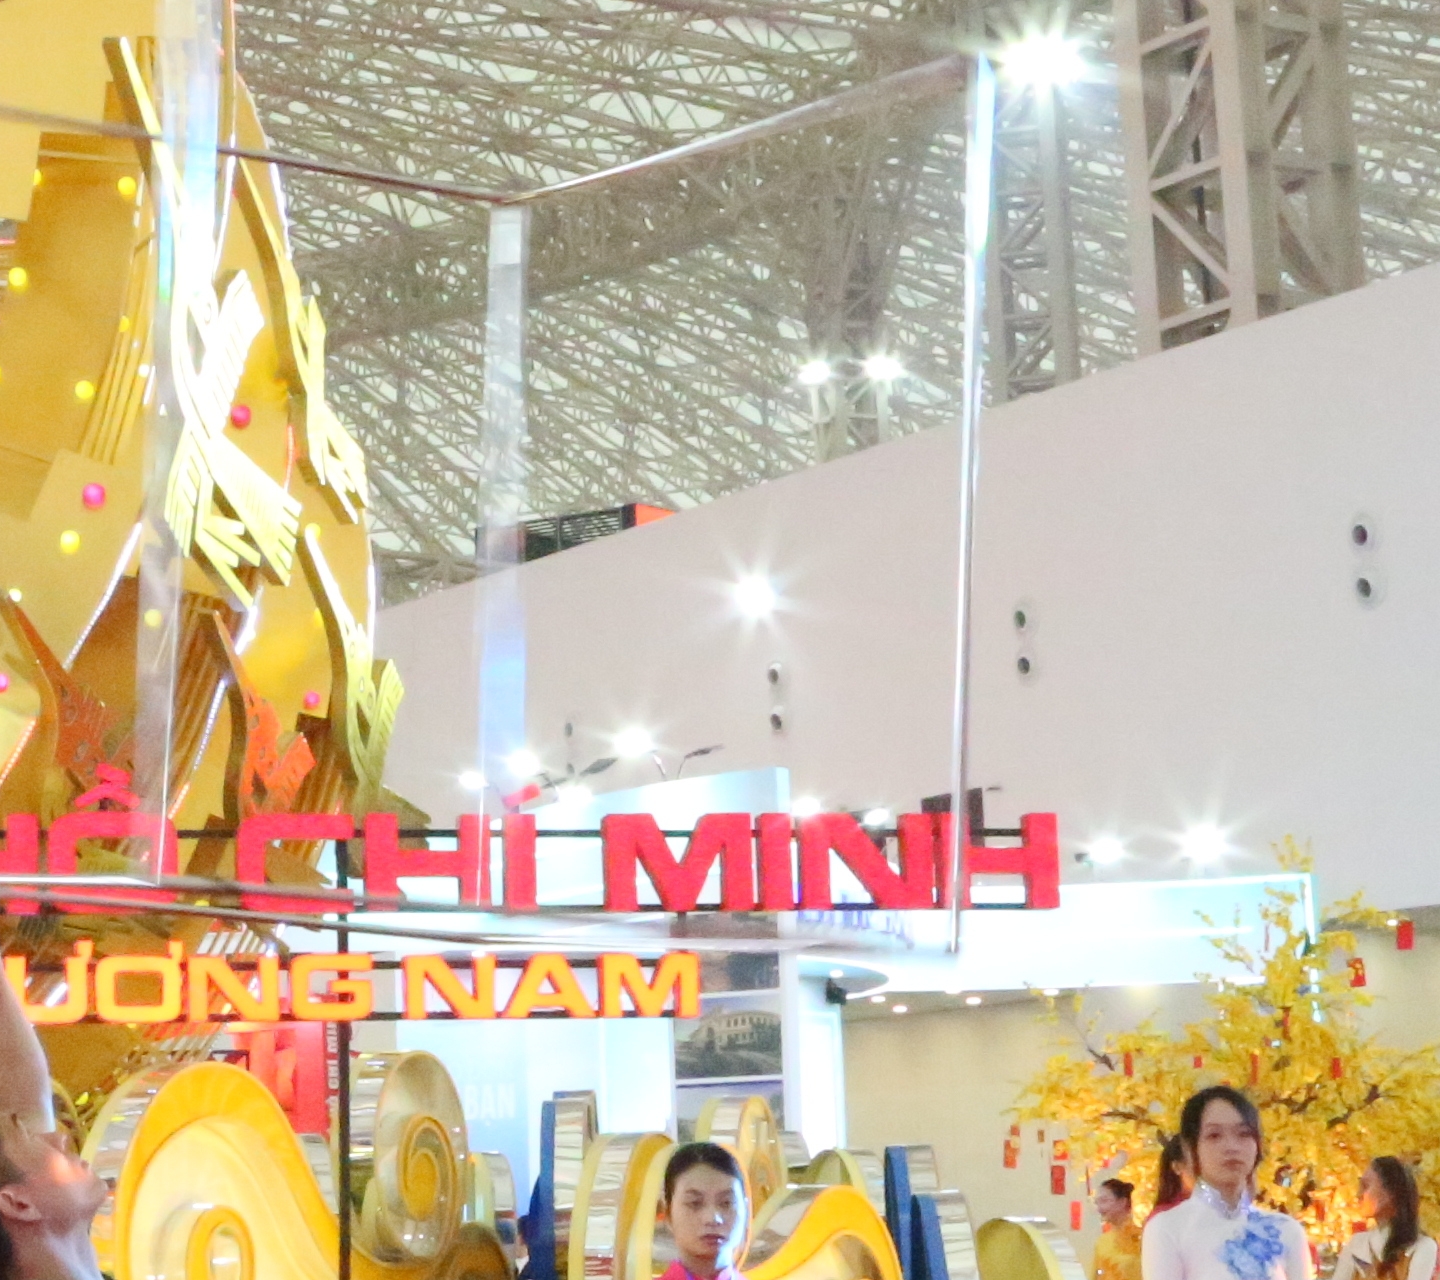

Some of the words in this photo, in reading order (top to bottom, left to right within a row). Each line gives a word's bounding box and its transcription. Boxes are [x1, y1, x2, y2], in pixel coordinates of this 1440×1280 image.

[236, 783, 538, 913] CHÍ
[601, 812, 1060, 913] MINH
[401, 950, 703, 1021] NAM
